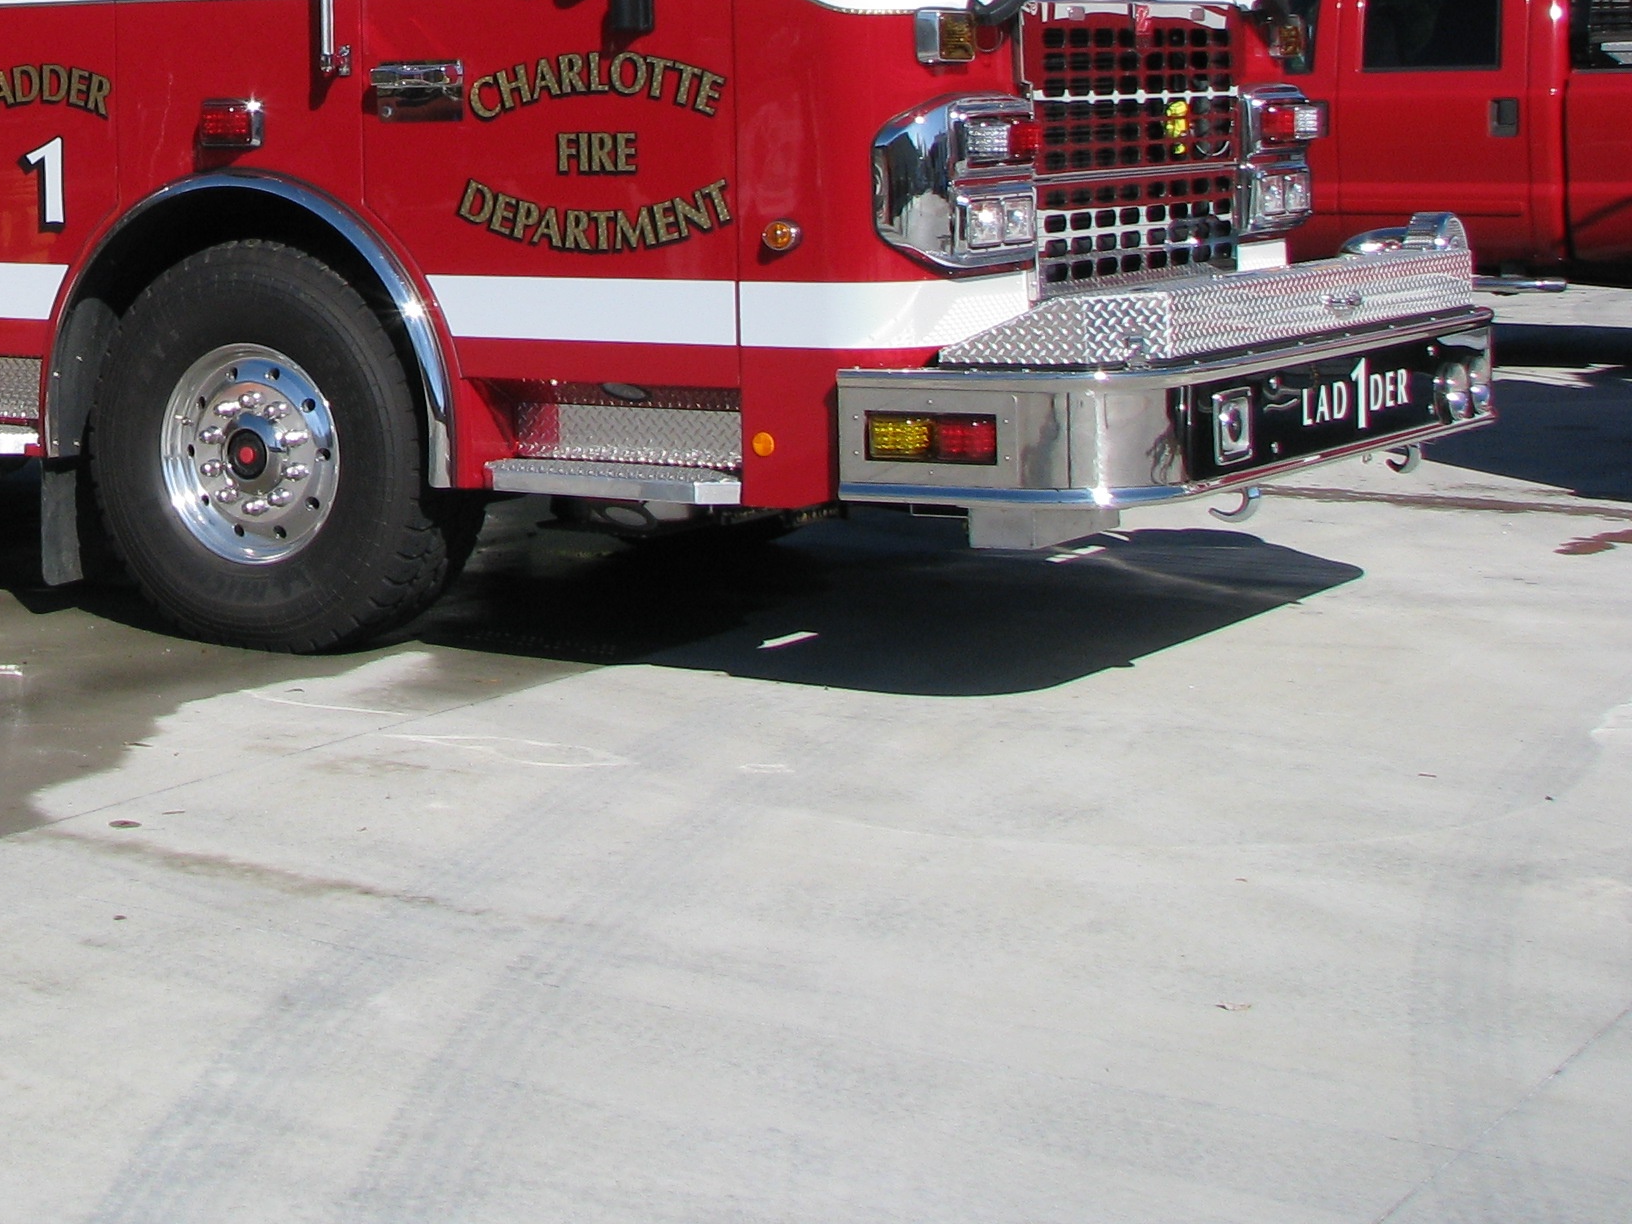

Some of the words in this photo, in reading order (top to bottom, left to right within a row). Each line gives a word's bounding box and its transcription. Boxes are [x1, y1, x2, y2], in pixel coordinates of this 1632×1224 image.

[469, 51, 726, 120] CHARLOTTE
[23, 136, 65, 226] 1
[557, 131, 638, 173] FIRE
[459, 178, 734, 253] DEPARTMENT
